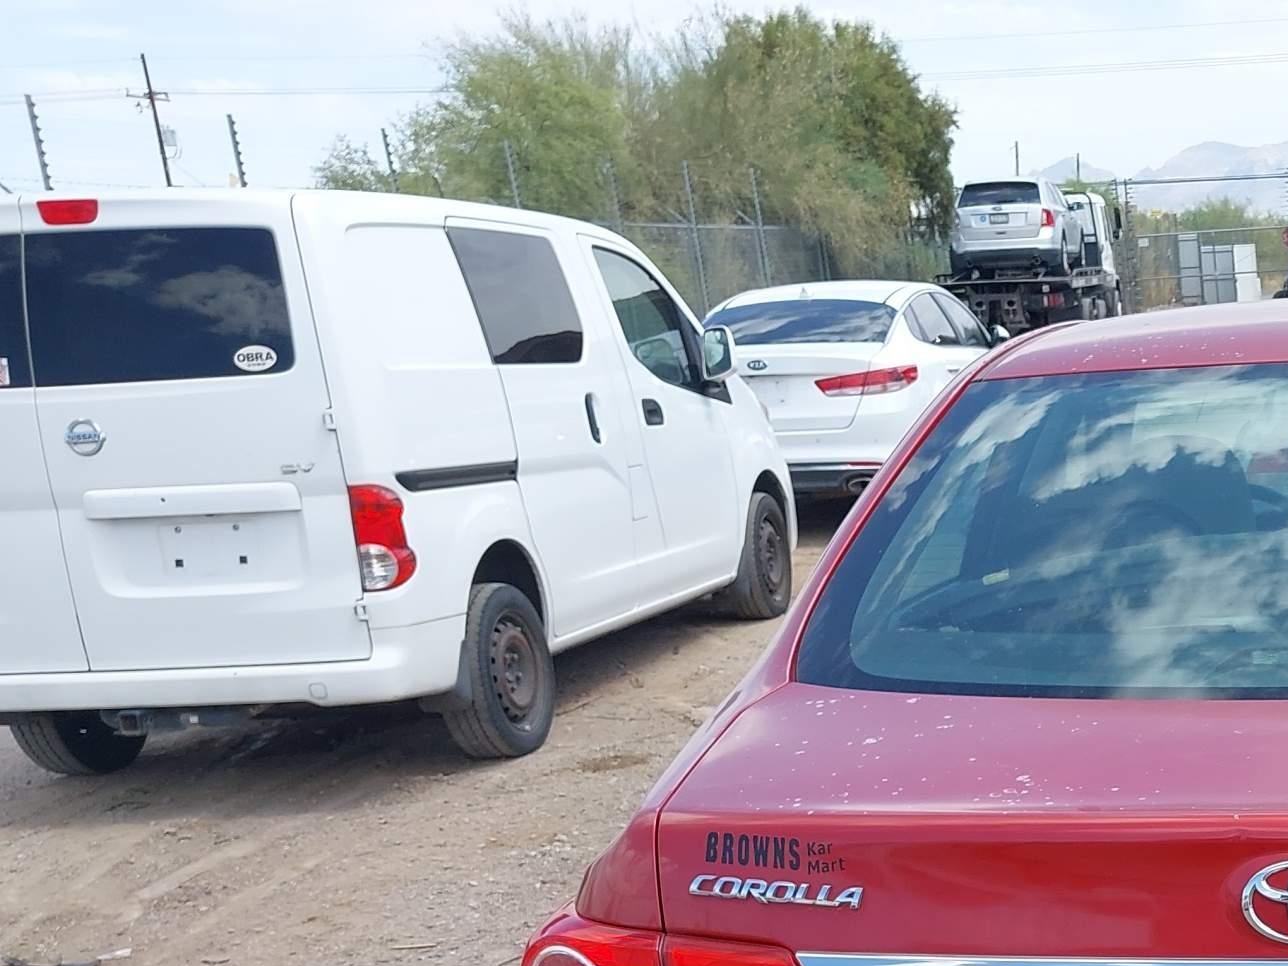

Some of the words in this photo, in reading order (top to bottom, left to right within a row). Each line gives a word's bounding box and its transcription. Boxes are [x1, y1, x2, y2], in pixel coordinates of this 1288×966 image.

[236, 351, 275, 363] OBRA
[704, 831, 801, 871] BROWNS
[806, 841, 833, 857] Kar
[806, 856, 847, 875] Mart
[688, 874, 865, 910] COROLLA
